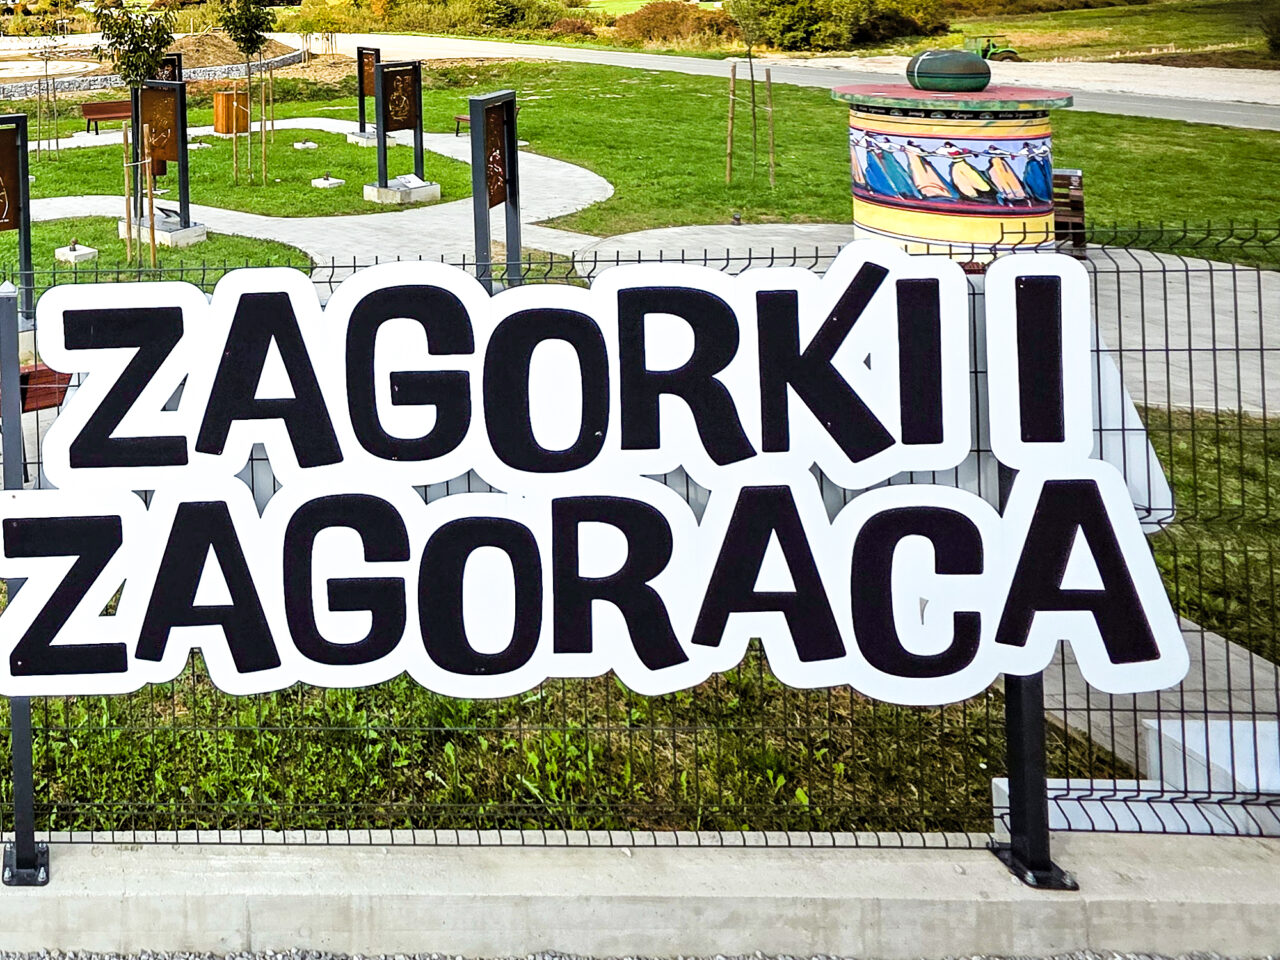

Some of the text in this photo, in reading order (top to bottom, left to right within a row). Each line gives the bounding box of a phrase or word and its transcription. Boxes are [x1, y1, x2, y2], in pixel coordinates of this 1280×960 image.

[63, 262, 1064, 468] ZAGORKI I
[3, 480, 1160, 678] ZAGORACA
